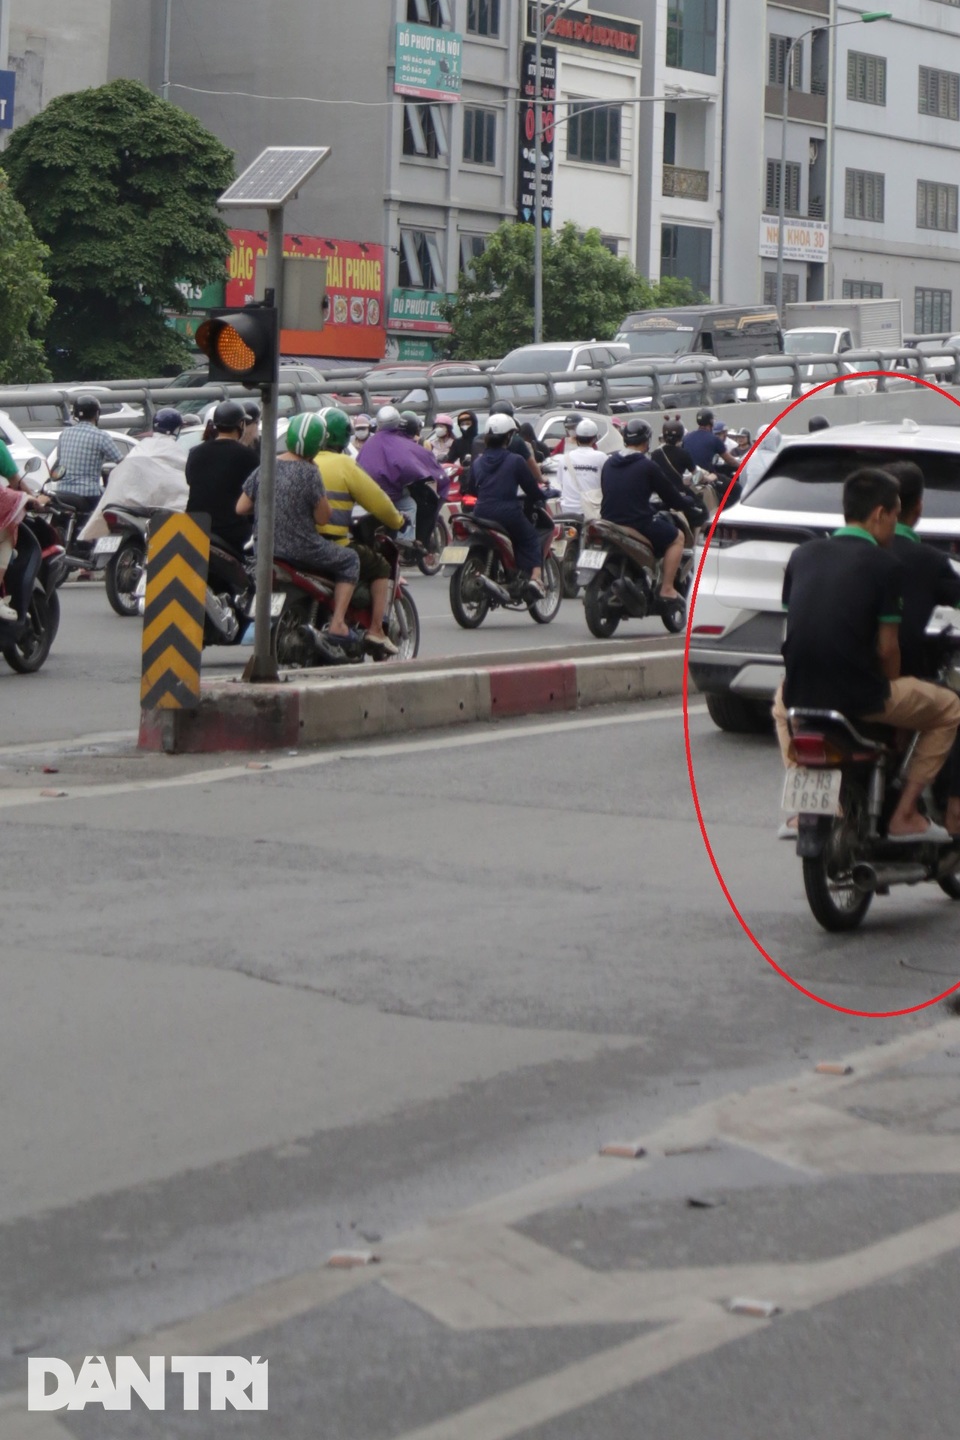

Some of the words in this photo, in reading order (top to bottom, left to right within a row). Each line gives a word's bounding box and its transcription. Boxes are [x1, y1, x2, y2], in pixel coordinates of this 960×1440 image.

[399, 29, 409, 47] ĐỒ
[411, 34, 434, 54] PHƯỢT
[436, 37, 446, 54] HÀ
[447, 39, 460, 59] NỘI
[787, 228, 811, 247] KHOA
[814, 231, 825, 249] 3D
[230, 240, 253, 286] ĐẶC
[346, 252, 381, 292] PHÒNG
[793, 772, 832, 790] 67-H3
[792, 791, 830, 809] 1856
